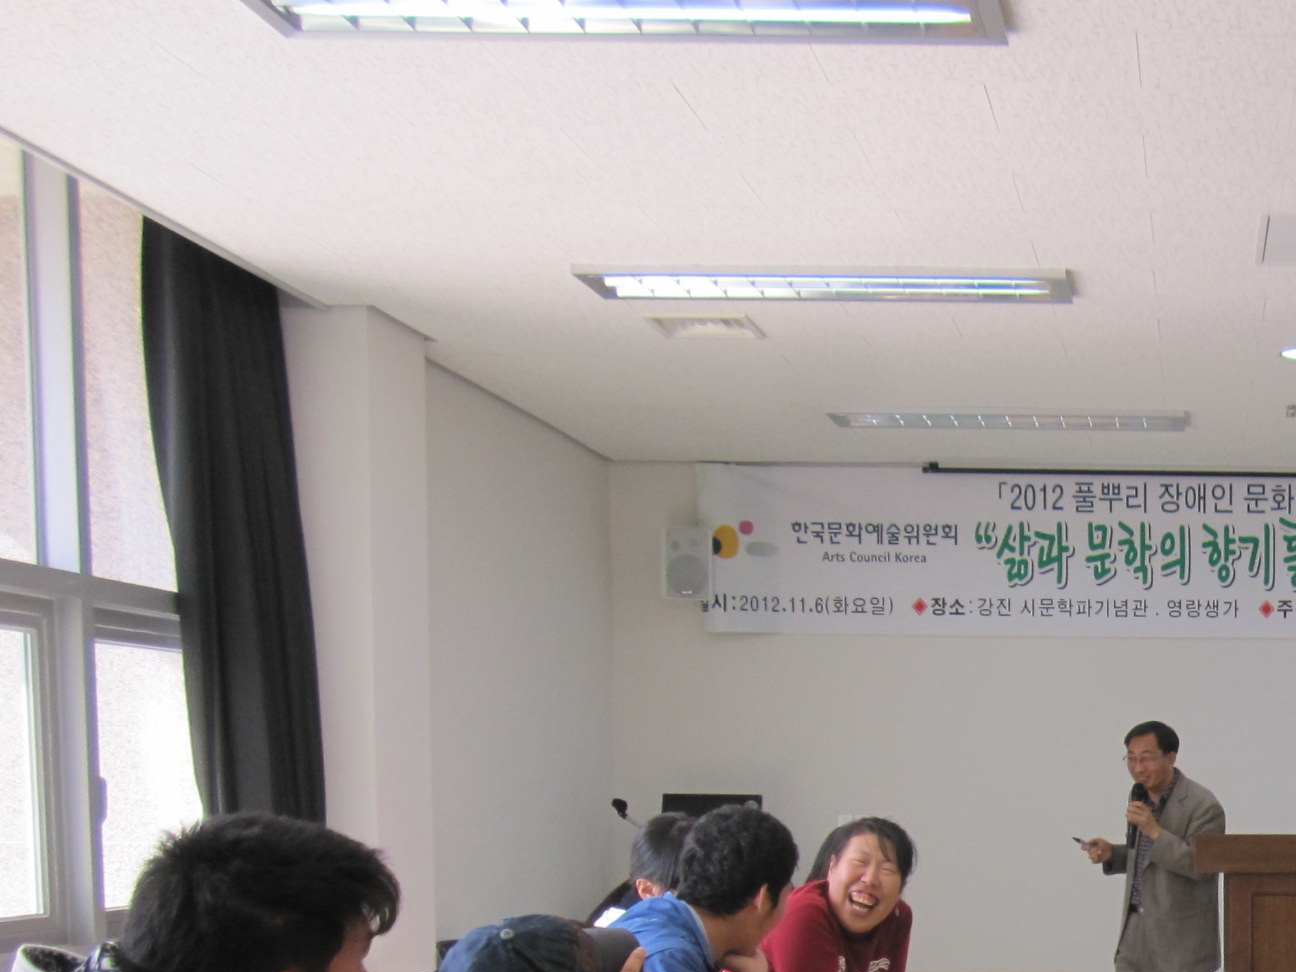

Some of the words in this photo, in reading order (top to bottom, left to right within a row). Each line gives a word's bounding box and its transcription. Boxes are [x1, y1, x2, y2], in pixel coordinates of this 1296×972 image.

[1072, 482, 1148, 513] 풀뿌리
[1158, 482, 1234, 514] 장애인
[790, 521, 959, 546] 한국문화예술위원회
[822, 551, 846, 564] Arts
[849, 551, 891, 564] Council
[894, 552, 928, 564] Korea
[1085, 520, 1190, 590] 문학의
[1020, 598, 1149, 618] 시문학파기념관
[1166, 599, 1240, 618] 영랑생가
